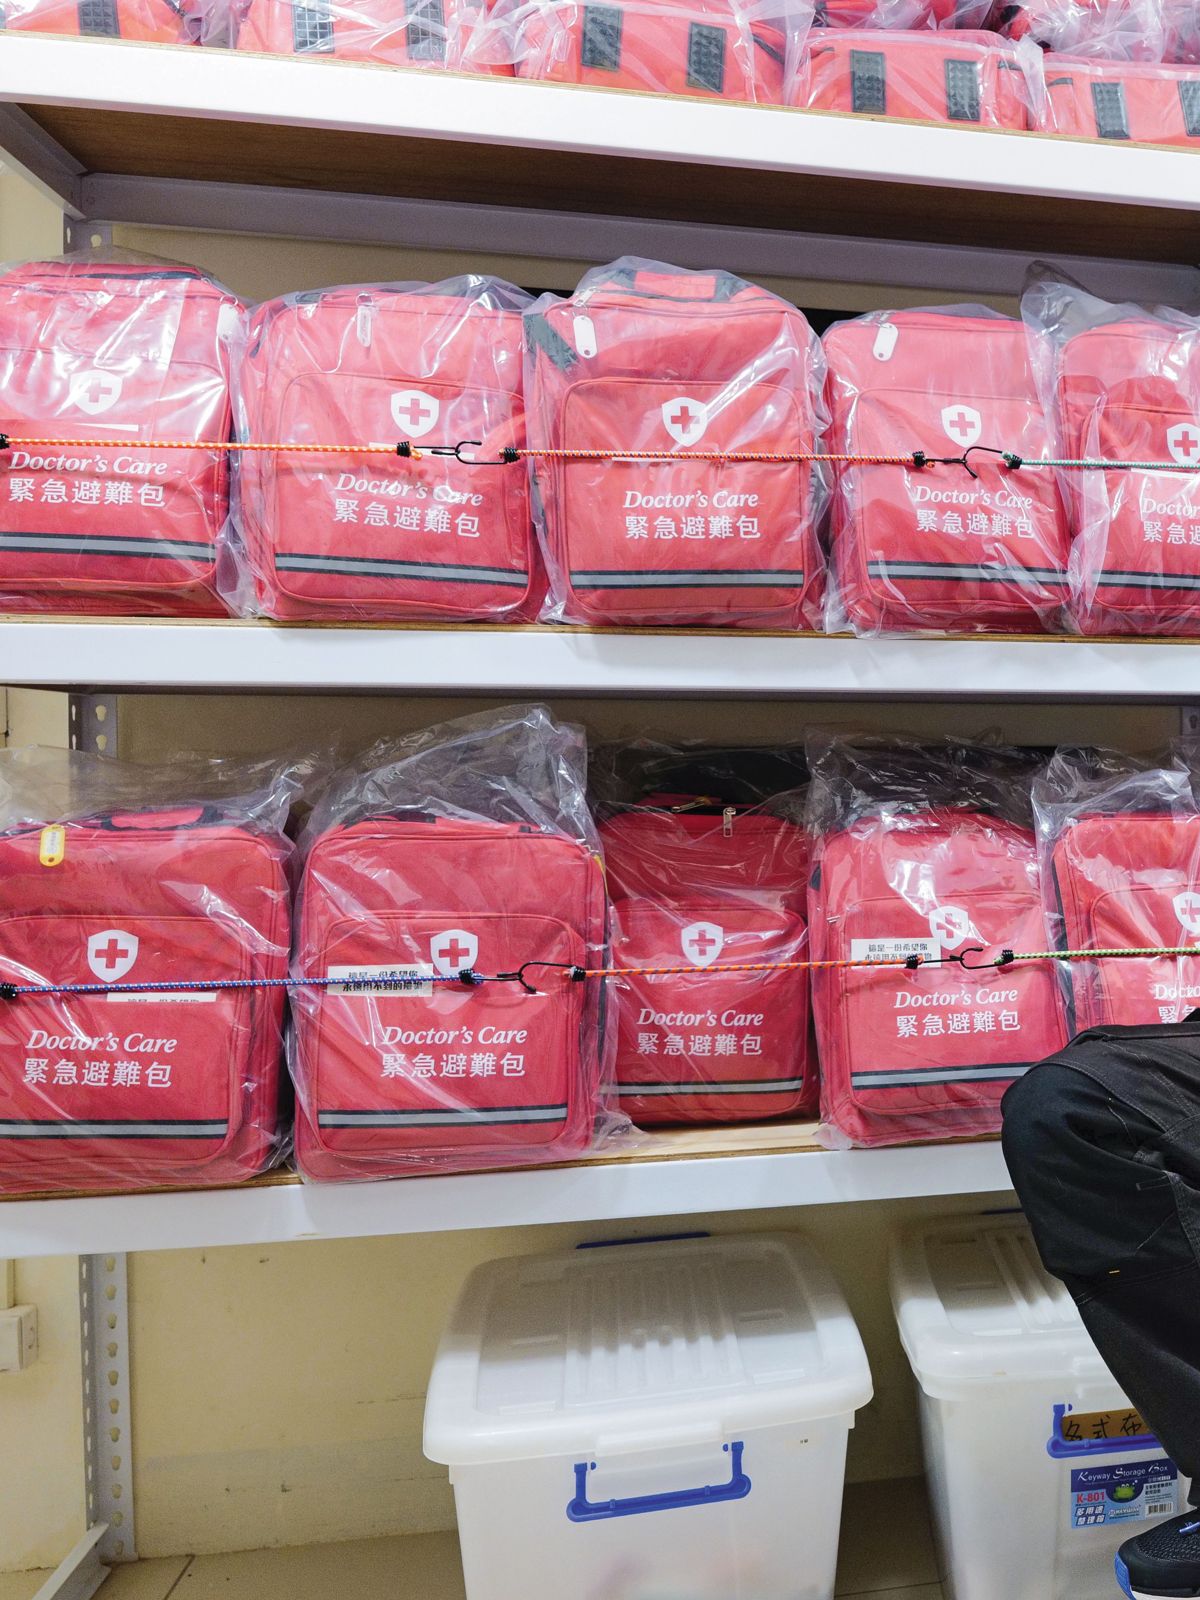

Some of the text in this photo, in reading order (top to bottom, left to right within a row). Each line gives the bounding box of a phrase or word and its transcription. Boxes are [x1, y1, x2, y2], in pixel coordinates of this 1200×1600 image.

[8, 451, 168, 476] Doctor's Care
[8, 478, 166, 508] 緊急避難包
[335, 473, 484, 507] Doctor's Care
[623, 490, 759, 509] Doctor's Care
[915, 486, 1034, 510] Doctor's Care
[334, 499, 481, 539] 緊急避難包
[624, 515, 761, 539] 緊急避難包
[916, 509, 1034, 539] 緊急避難包
[893, 987, 1019, 1009] Doctor's Care
[636, 1008, 764, 1027] Doctor's Care
[896, 1010, 1021, 1038] 緊急避難包
[25, 1030, 178, 1053] Doctor's Care
[381, 1025, 528, 1046] Doctor's Care
[636, 1032, 763, 1057] 緊急避難包
[23, 1057, 172, 1088] 緊急避難包
[380, 1051, 526, 1079] 緊急避難包
[1078, 1471, 1112, 1482] Keyway
[1113, 1466, 1146, 1480] Storage
[1148, 1462, 1169, 1474] Box
[1077, 1491, 1105, 1504] K-801
